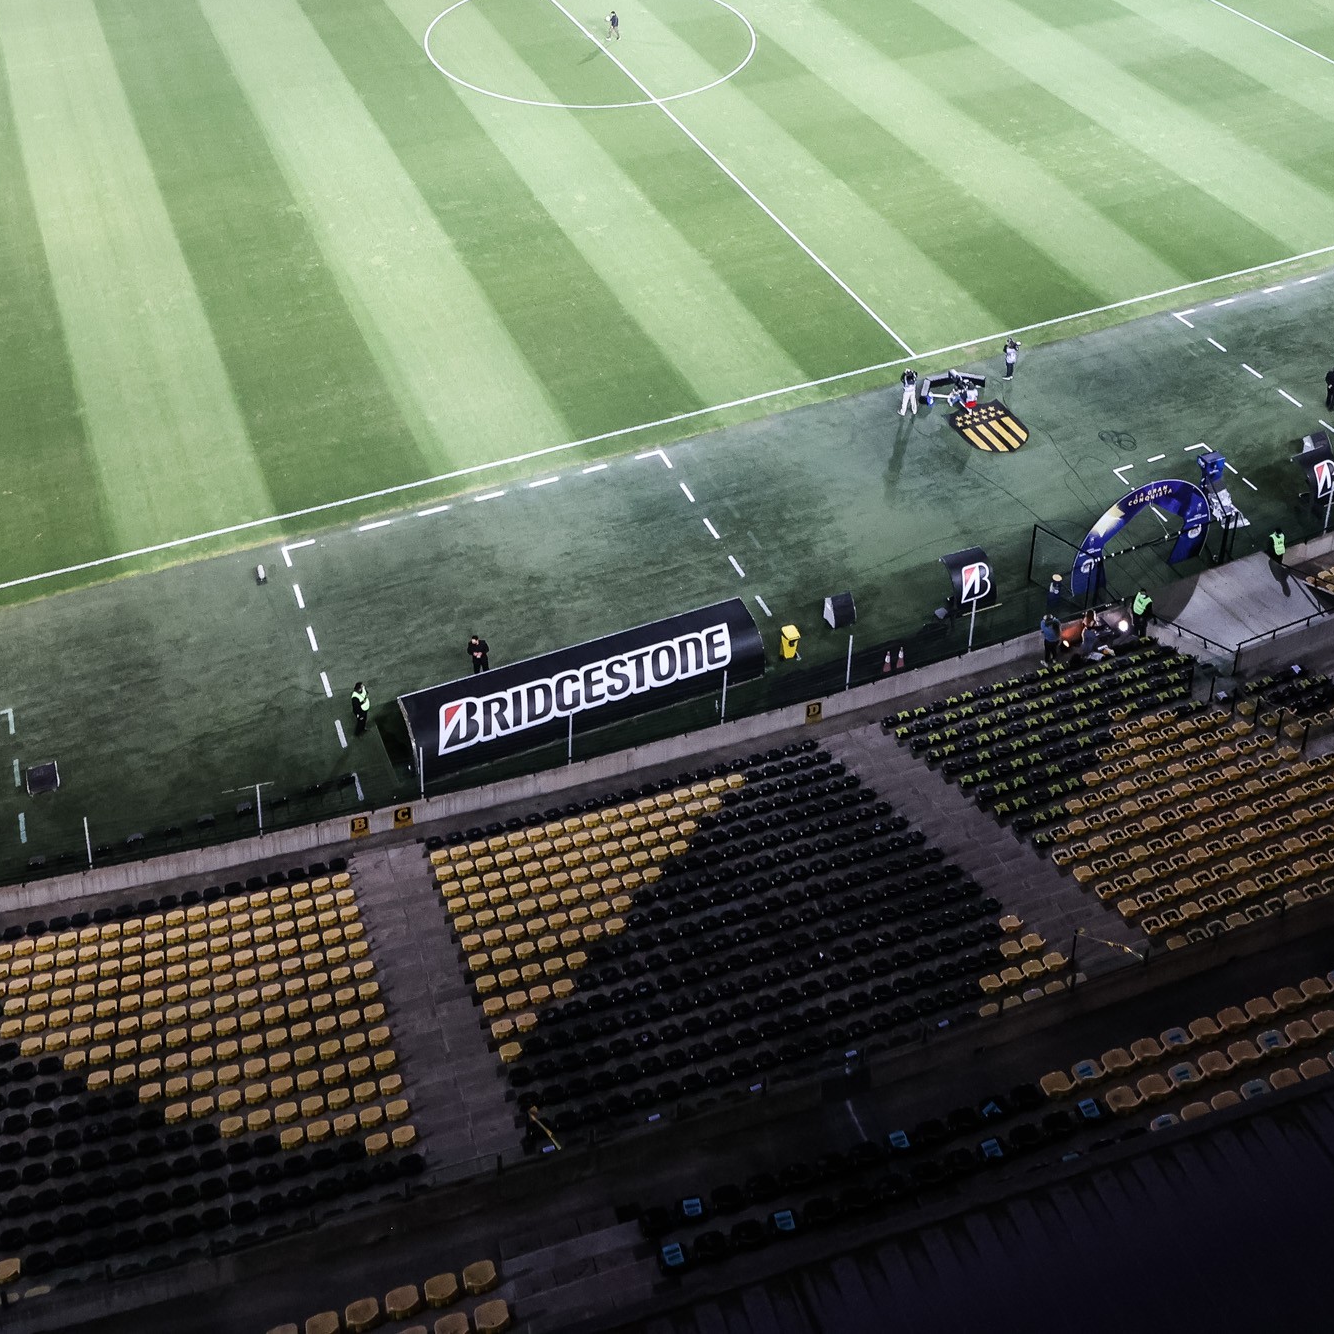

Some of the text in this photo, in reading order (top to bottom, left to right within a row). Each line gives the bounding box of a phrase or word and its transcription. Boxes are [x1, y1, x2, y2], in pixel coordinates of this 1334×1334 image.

[1127, 487, 1174, 507] CONQUISTA
[438, 621, 733, 757] BRIDGESTONE
[806, 703, 821, 717] D
[396, 807, 411, 822] C
[352, 817, 368, 832] B
